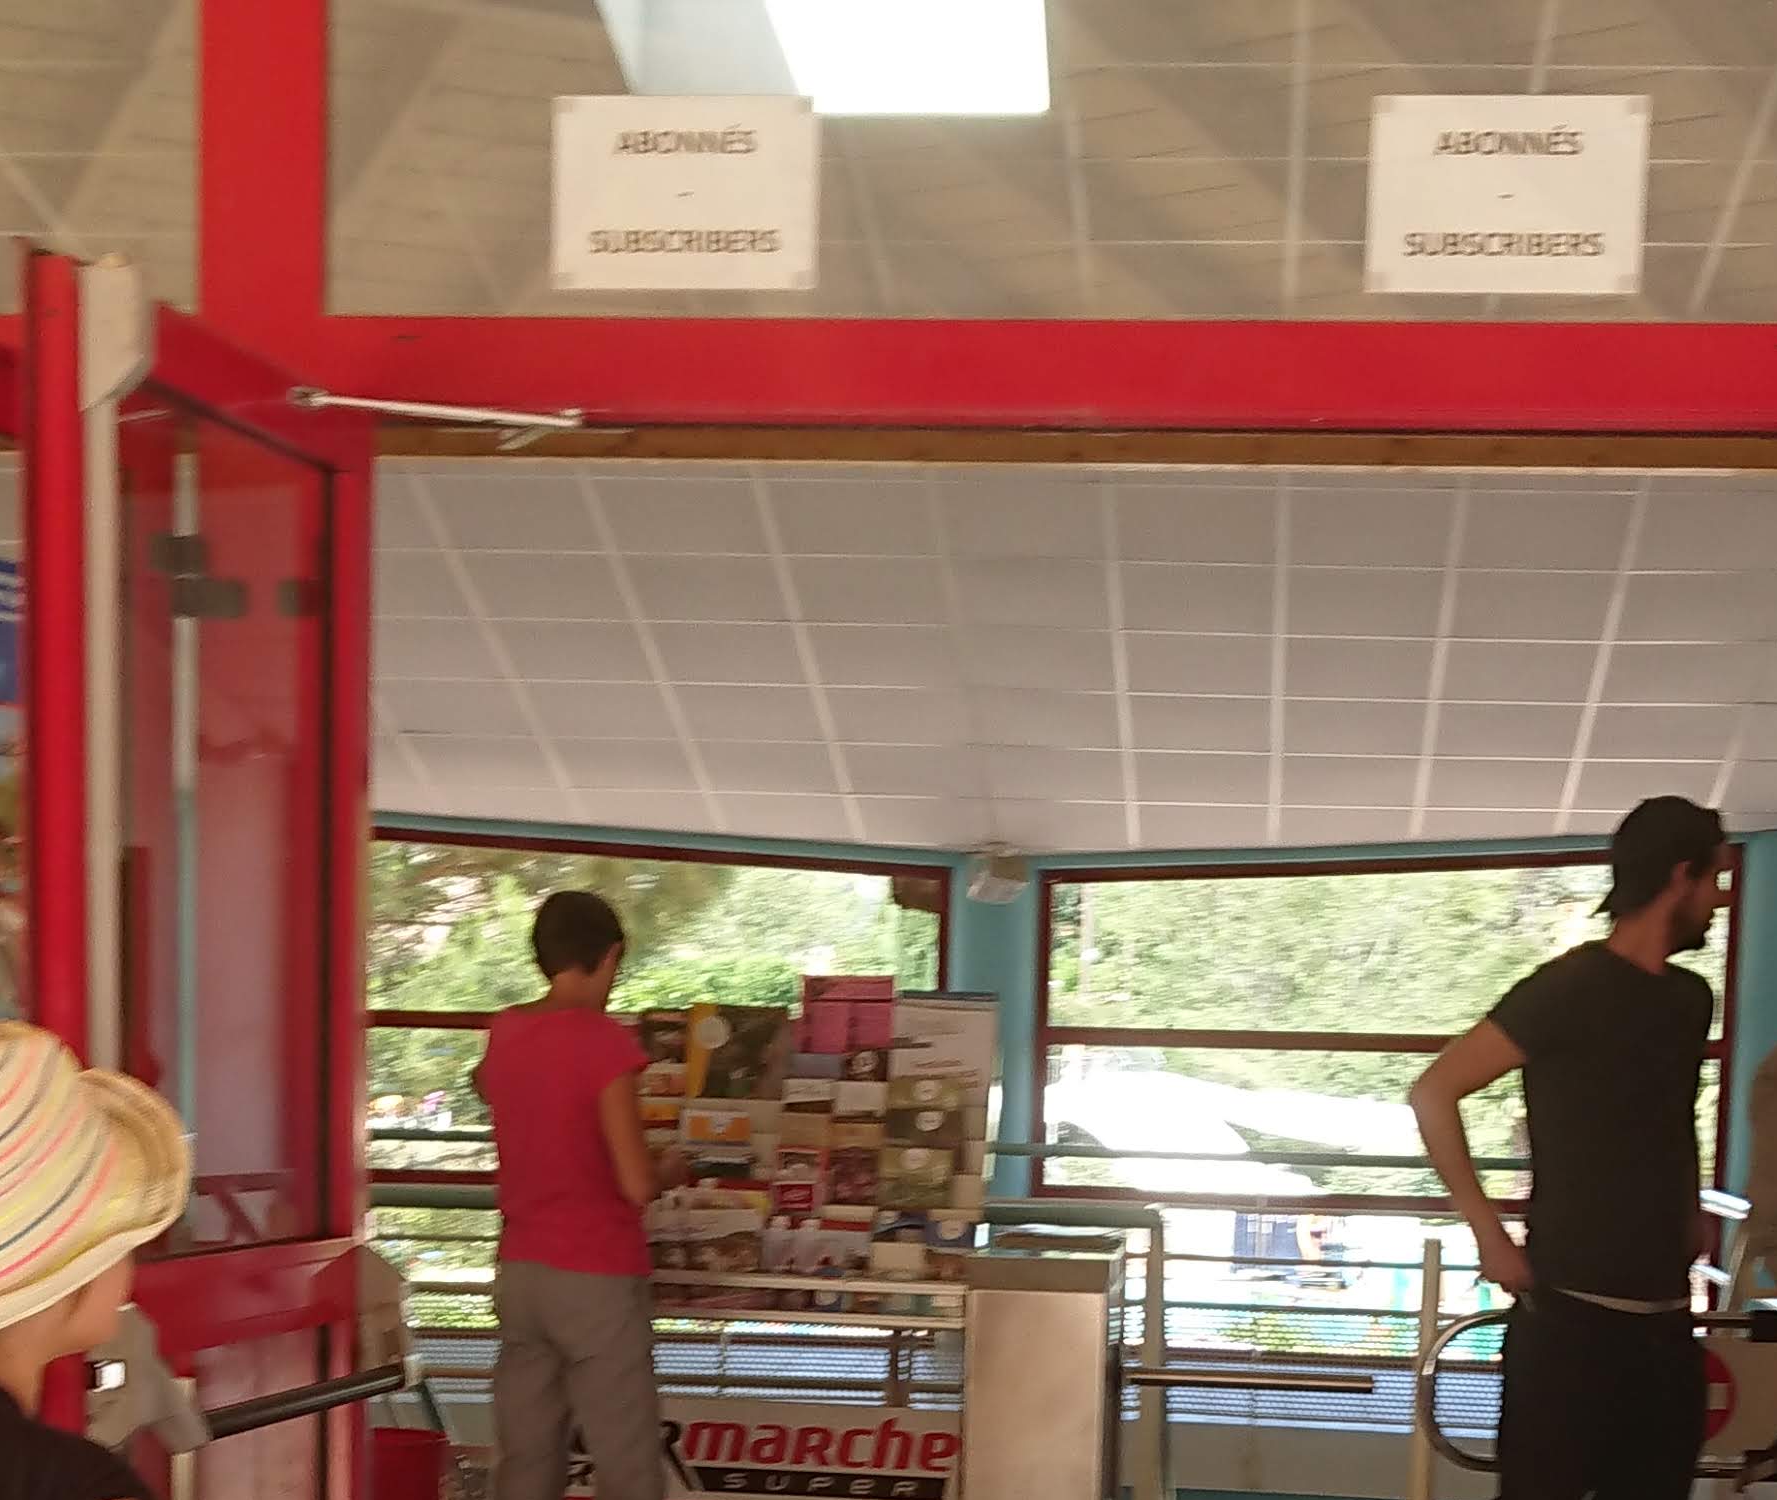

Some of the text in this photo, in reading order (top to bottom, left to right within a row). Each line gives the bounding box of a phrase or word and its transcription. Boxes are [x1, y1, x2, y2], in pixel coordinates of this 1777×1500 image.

[614, 122, 758, 155] ABONNÉS
[1433, 120, 1583, 156] ABONNÉS
[589, 229, 782, 254] SUBSCRIBERS
[1403, 232, 1606, 257] SUBSCRIBERS
[723, 1471, 920, 1497] SUPER
